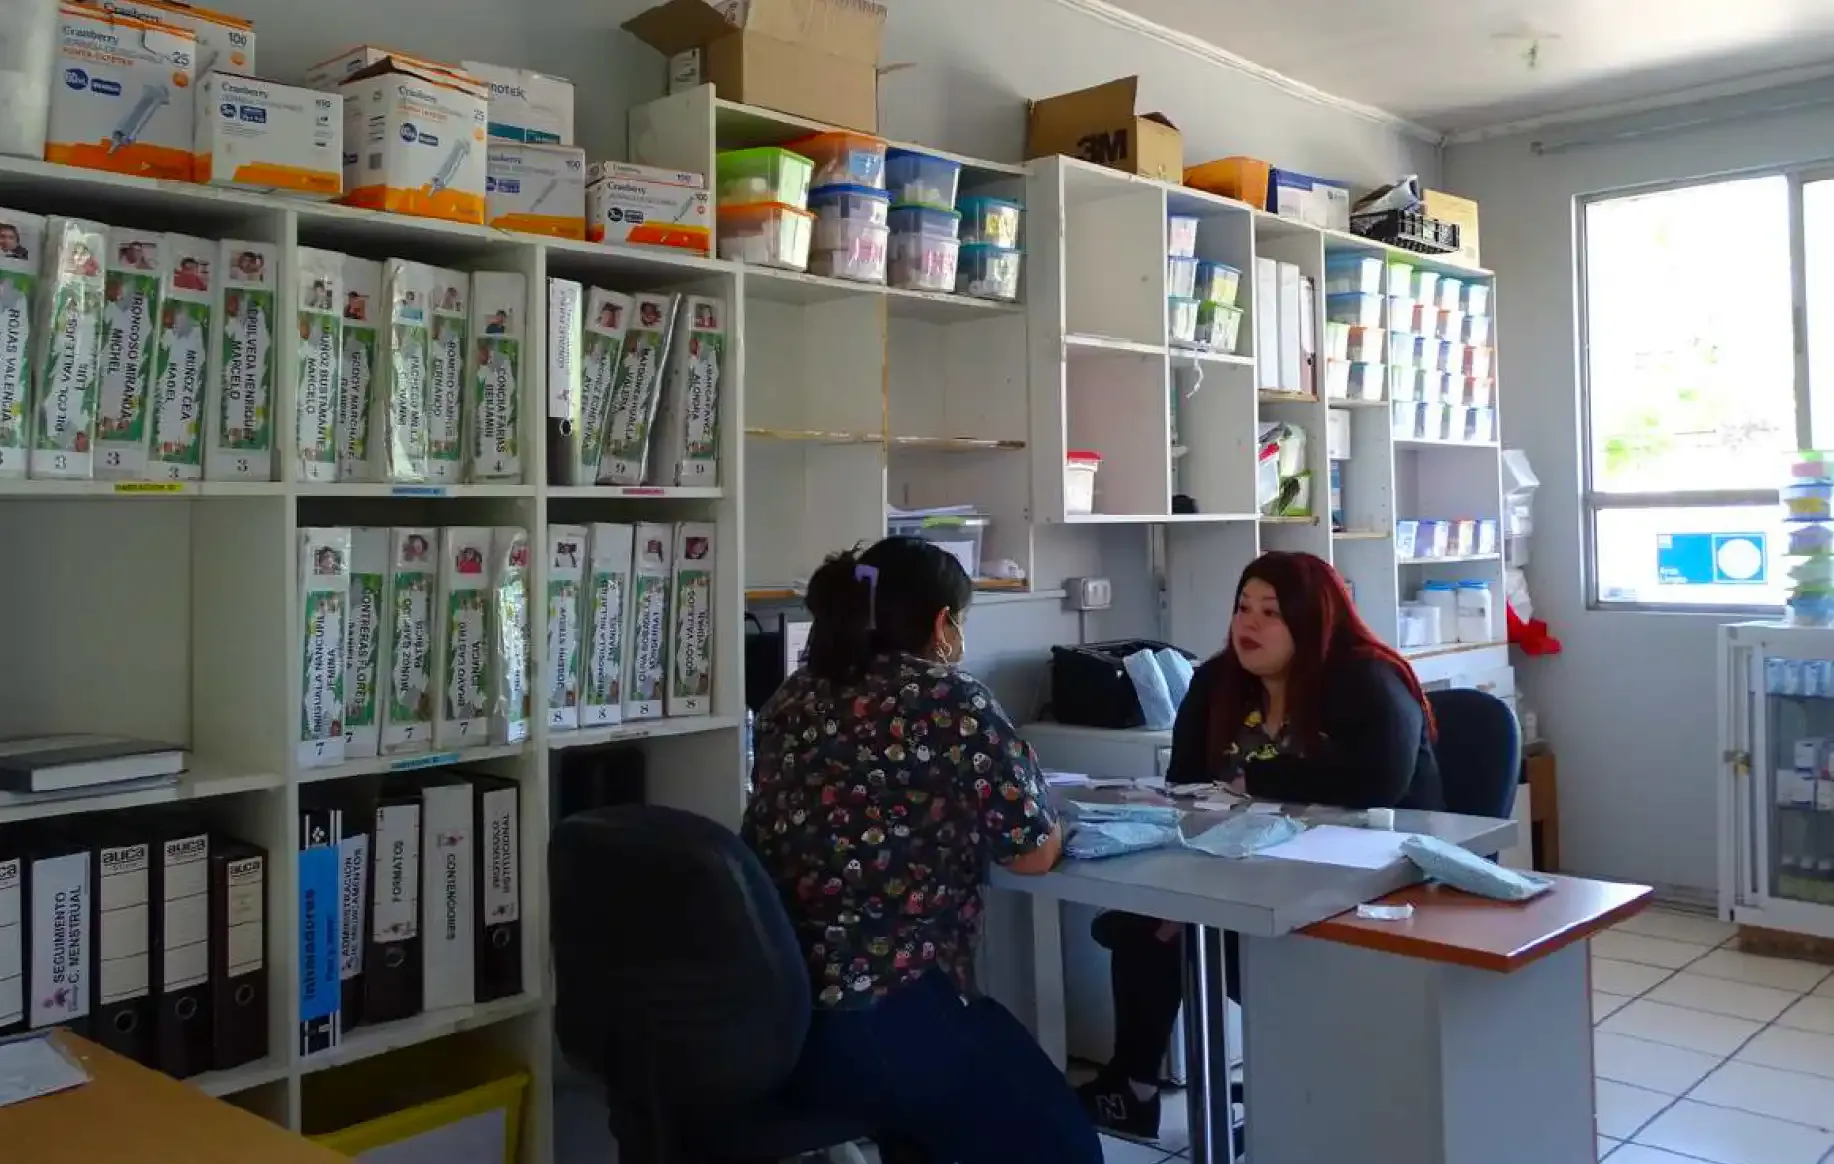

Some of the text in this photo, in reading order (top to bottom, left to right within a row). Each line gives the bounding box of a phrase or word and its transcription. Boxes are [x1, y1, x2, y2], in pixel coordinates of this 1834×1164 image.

[172, 51, 190, 67] 25
[1076, 128, 1127, 163] 3M
[108, 328, 123, 375] MICHEL
[230, 340, 243, 401] MARCELO
[107, 452, 120, 466] 3
